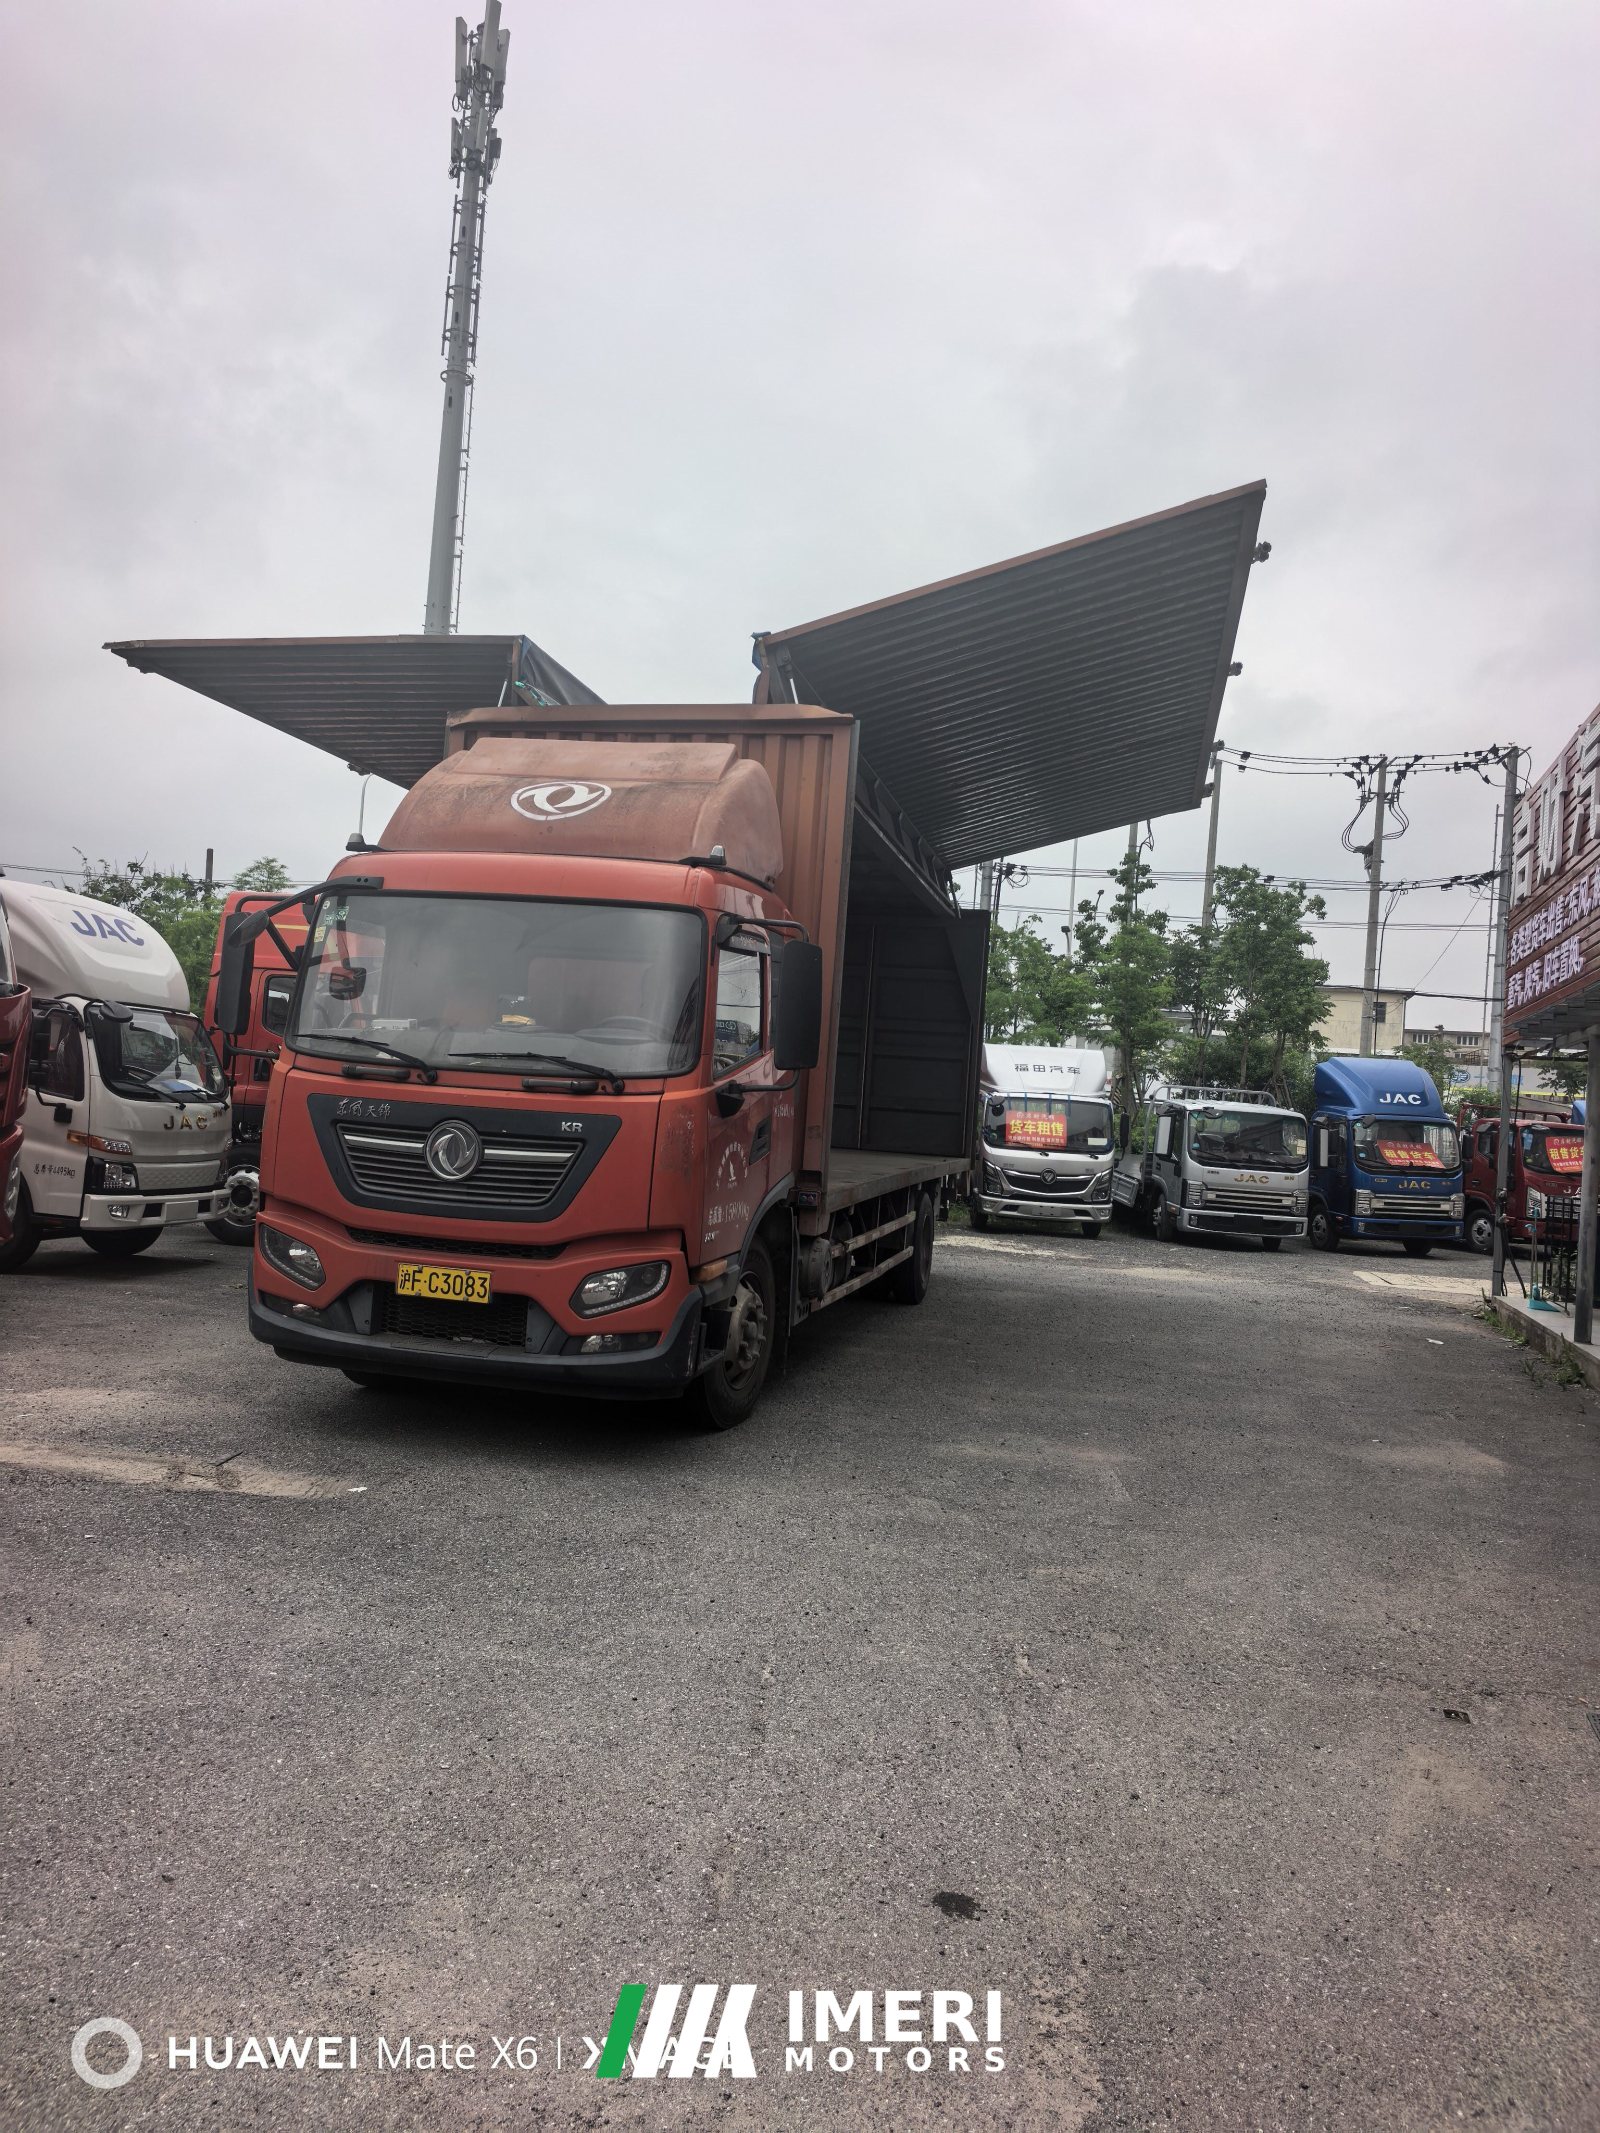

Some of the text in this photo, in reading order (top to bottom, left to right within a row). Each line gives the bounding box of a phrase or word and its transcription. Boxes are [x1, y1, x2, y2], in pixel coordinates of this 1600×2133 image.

[70, 909, 145, 946] JAC
[1014, 1063, 1081, 1075] 福田汽车
[1379, 1093, 1422, 1105] JAC
[163, 1114, 208, 1131] JAC
[561, 1121, 583, 1132] KR
[1009, 1119, 1064, 1137] 货车租售
[1383, 1149, 1436, 1160] 租售货车
[1233, 1173, 1270, 1184] JAC
[1398, 1180, 1432, 1189] JAC
